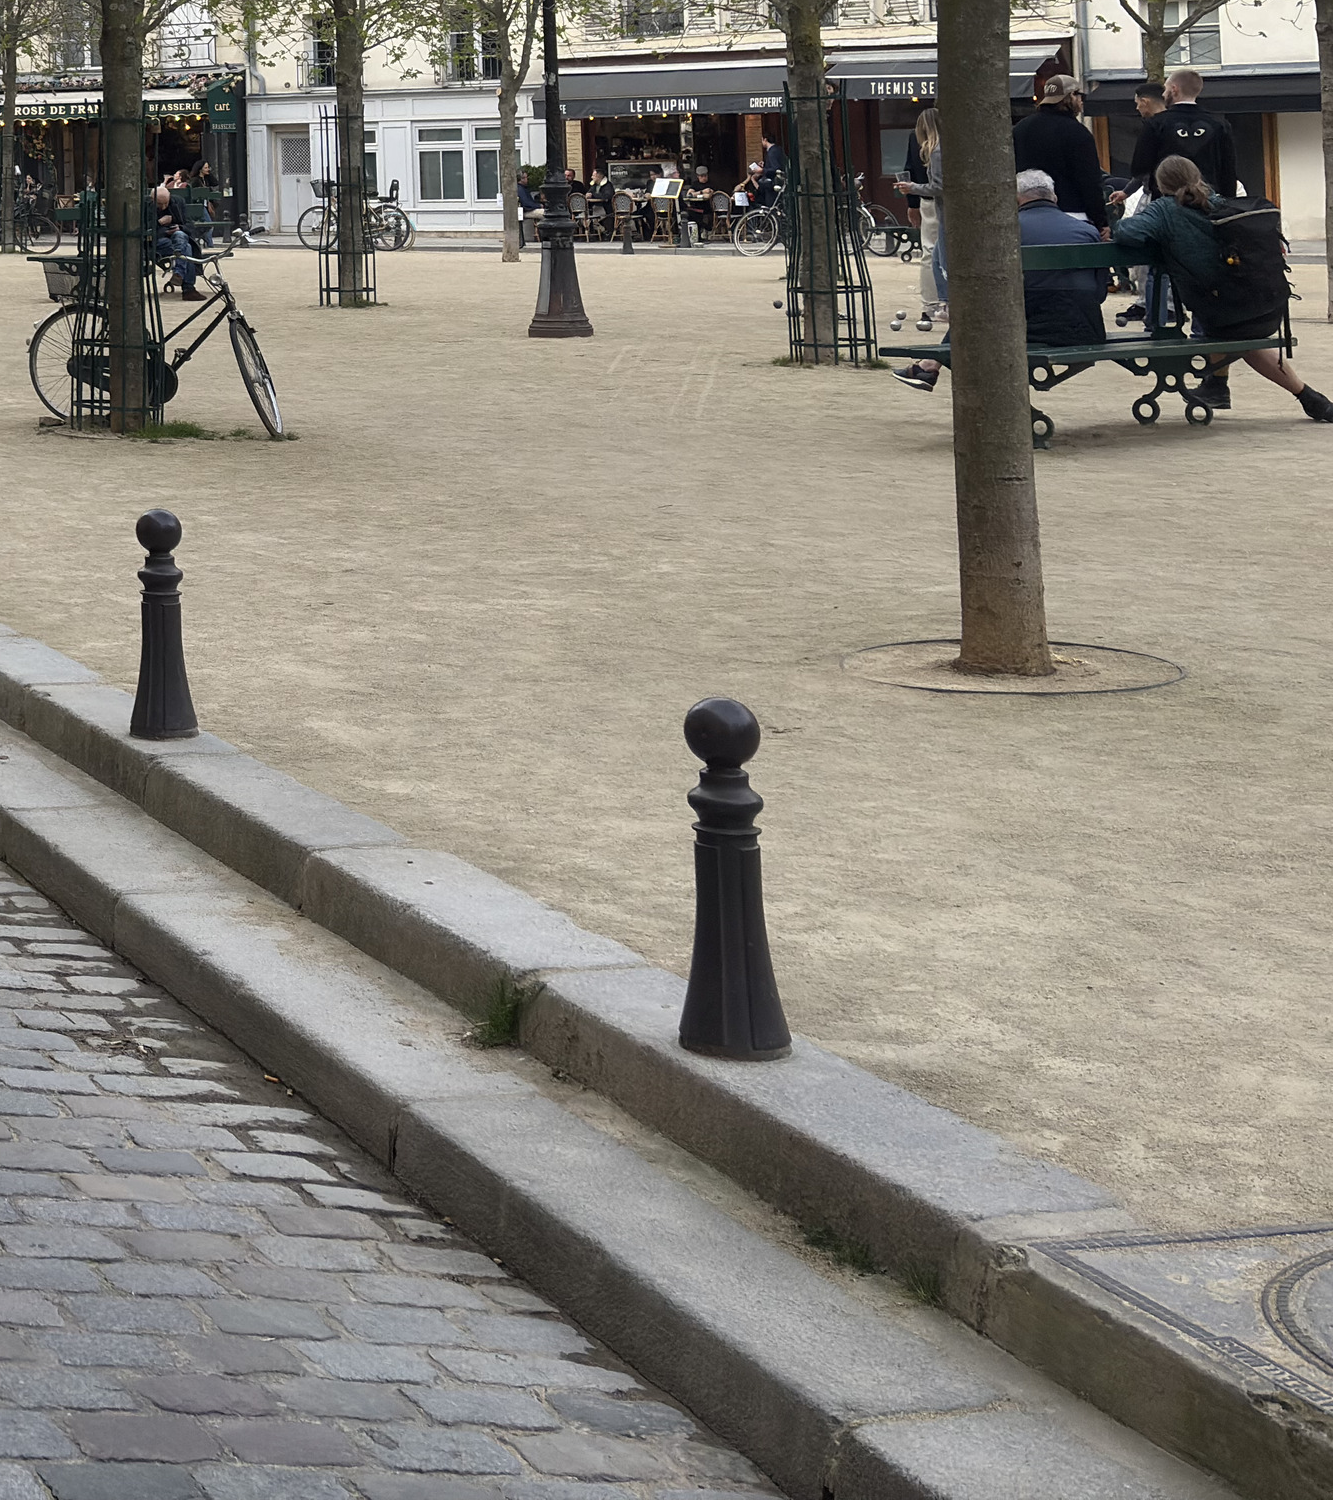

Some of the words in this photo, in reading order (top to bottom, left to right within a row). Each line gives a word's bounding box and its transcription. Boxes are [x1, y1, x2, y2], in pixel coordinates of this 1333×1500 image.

[870, 81, 914, 96] THEMIS
[921, 81, 935, 95] SE
[14, 106, 46, 116] ROSE
[49, 106, 66, 116] DE
[630, 100, 643, 113] LE
[646, 98, 699, 112] DAUPHIN
